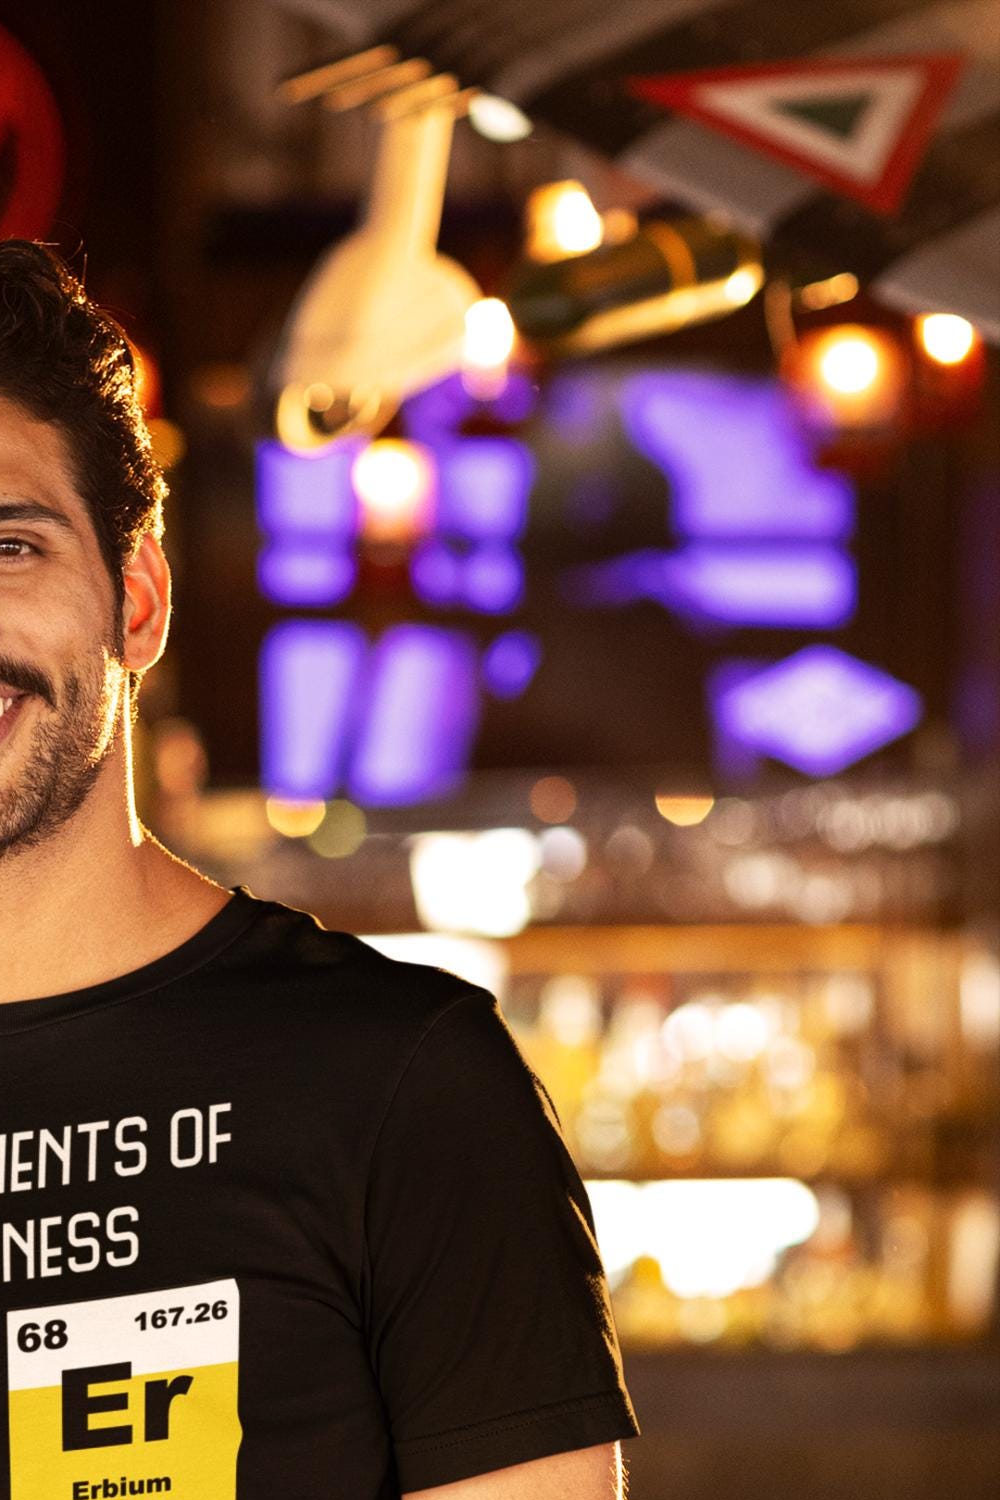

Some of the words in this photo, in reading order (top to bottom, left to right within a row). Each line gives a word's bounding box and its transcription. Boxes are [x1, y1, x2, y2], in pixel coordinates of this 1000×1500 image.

[169, 1102, 232, 1168] OF
[16, 1319, 69, 1353] 68
[134, 1300, 228, 1331] 167.26
[61, 1361, 194, 1452] Er
